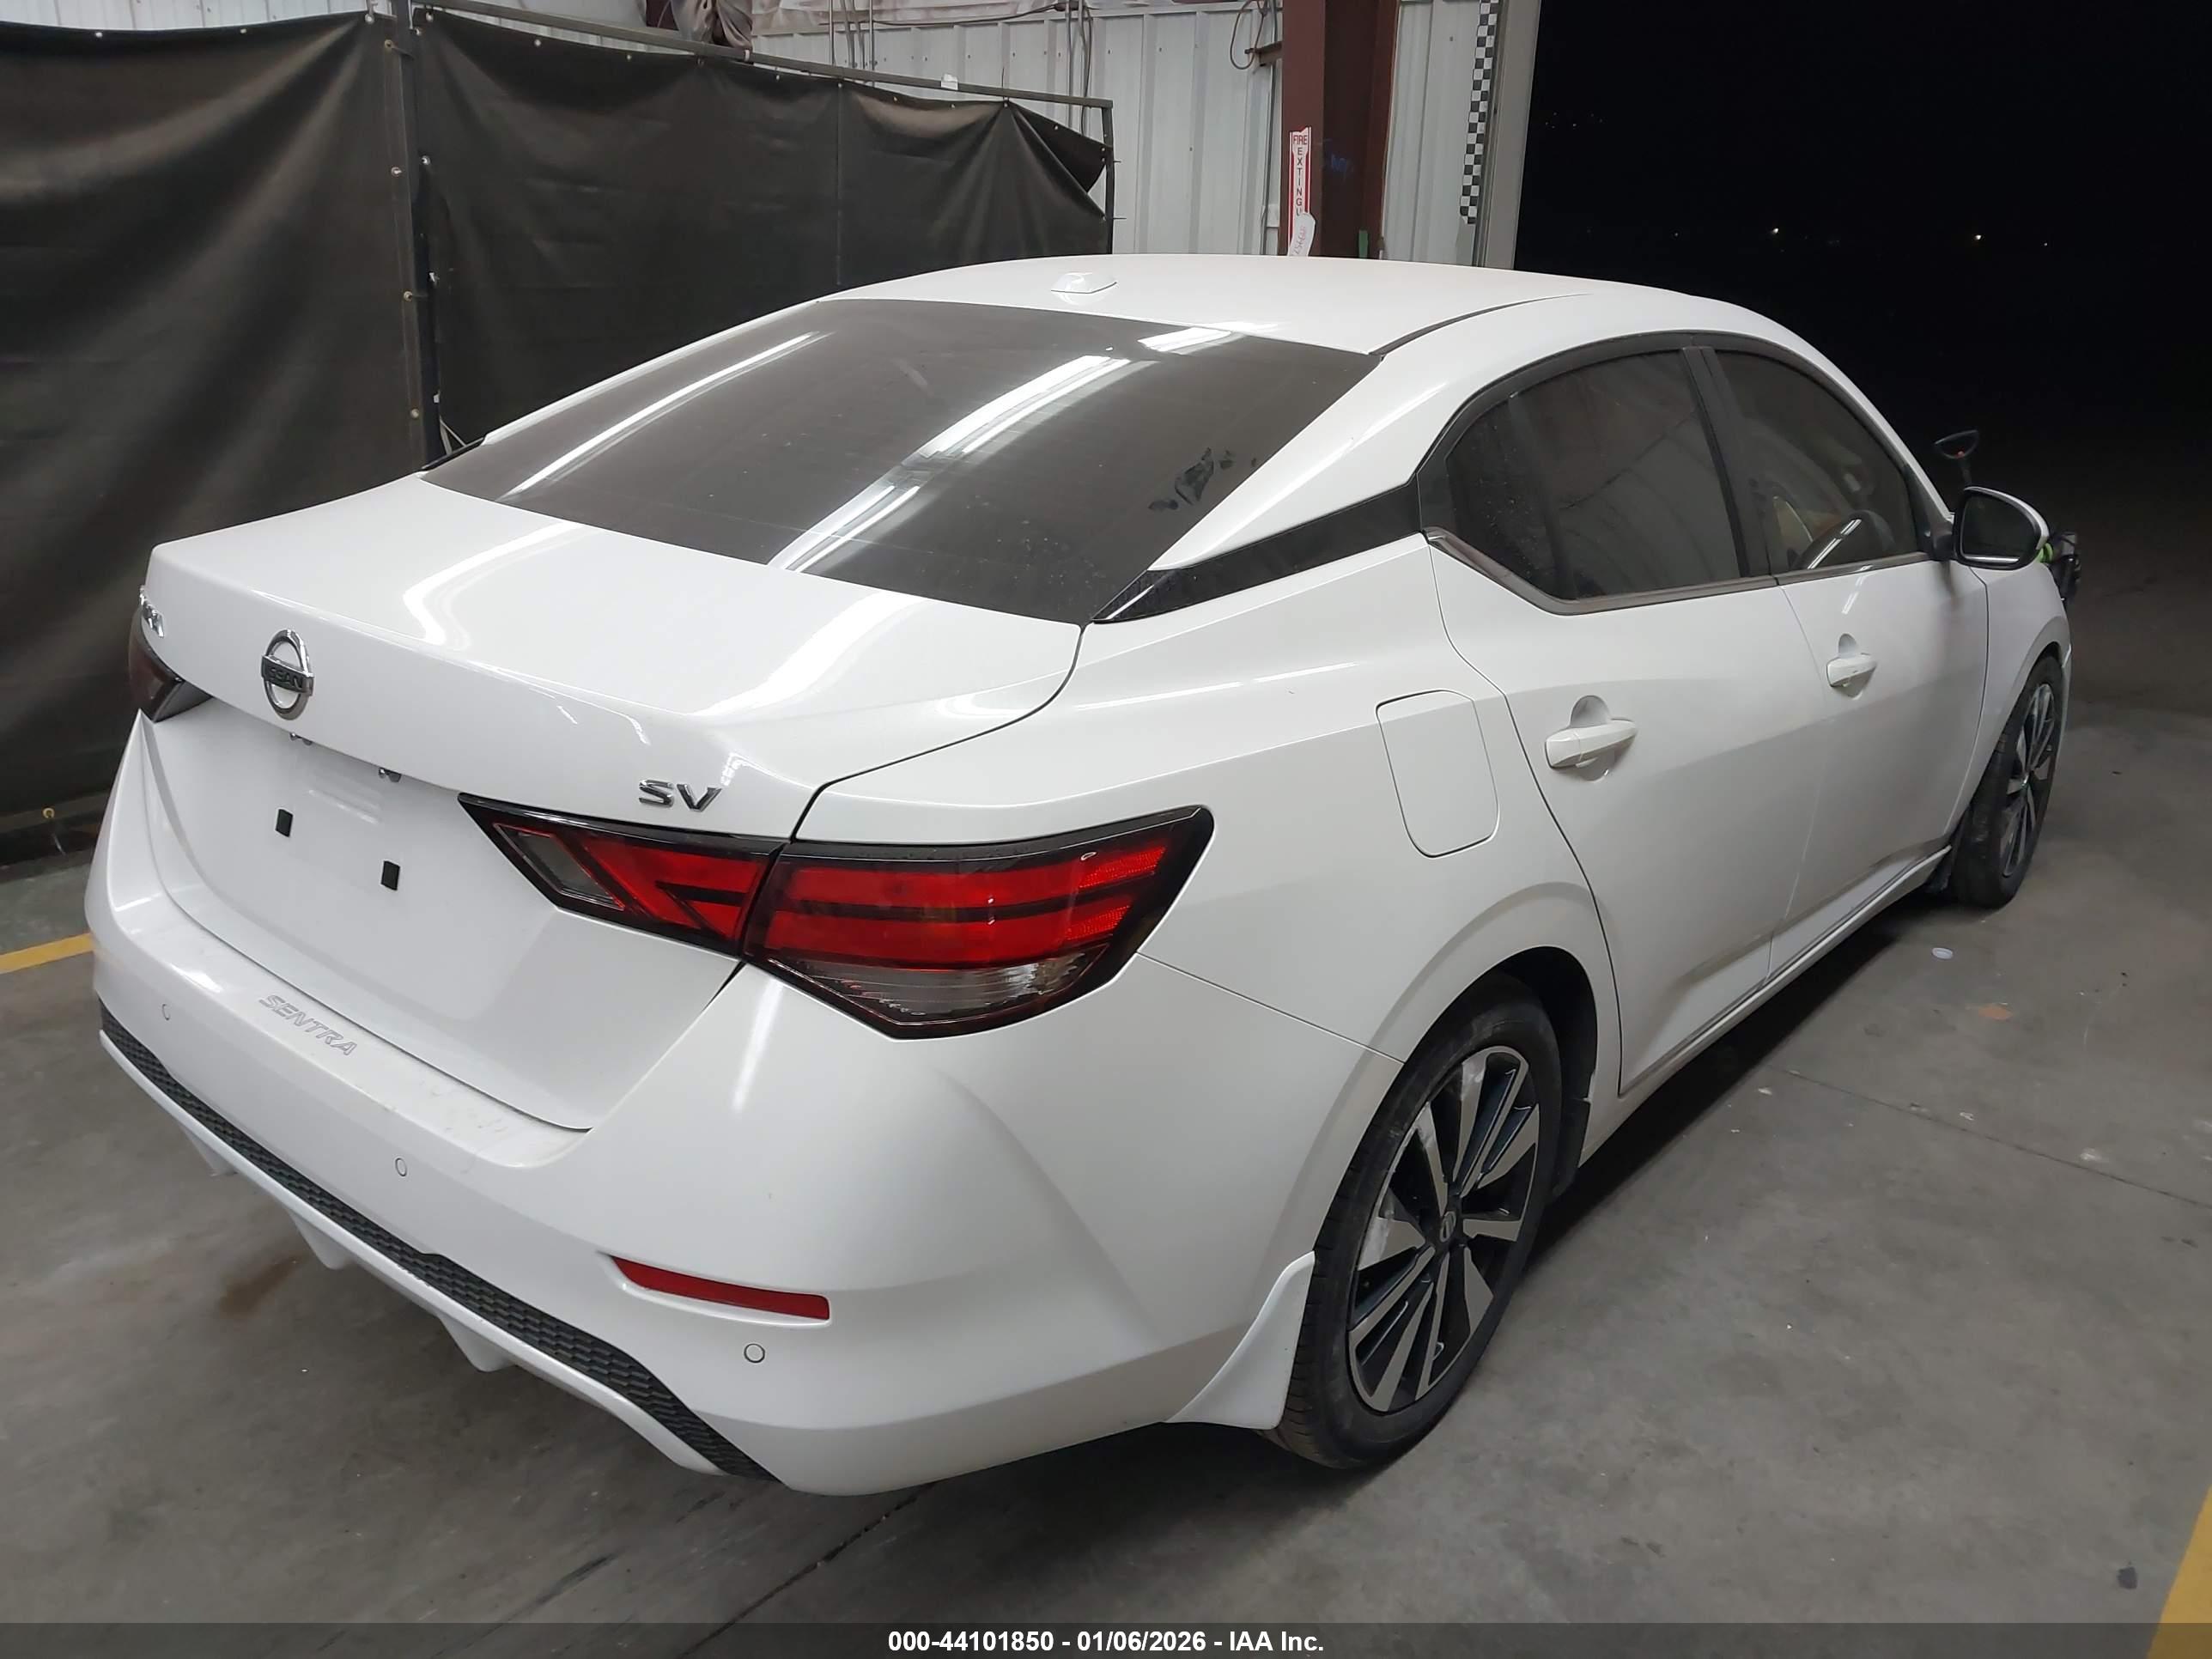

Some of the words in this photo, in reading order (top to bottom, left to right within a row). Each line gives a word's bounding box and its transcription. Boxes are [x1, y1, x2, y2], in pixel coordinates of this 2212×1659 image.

[1293, 135, 1308, 145] FIRE
[639, 779, 722, 812] SV
[258, 994, 358, 1056] SENTRA
